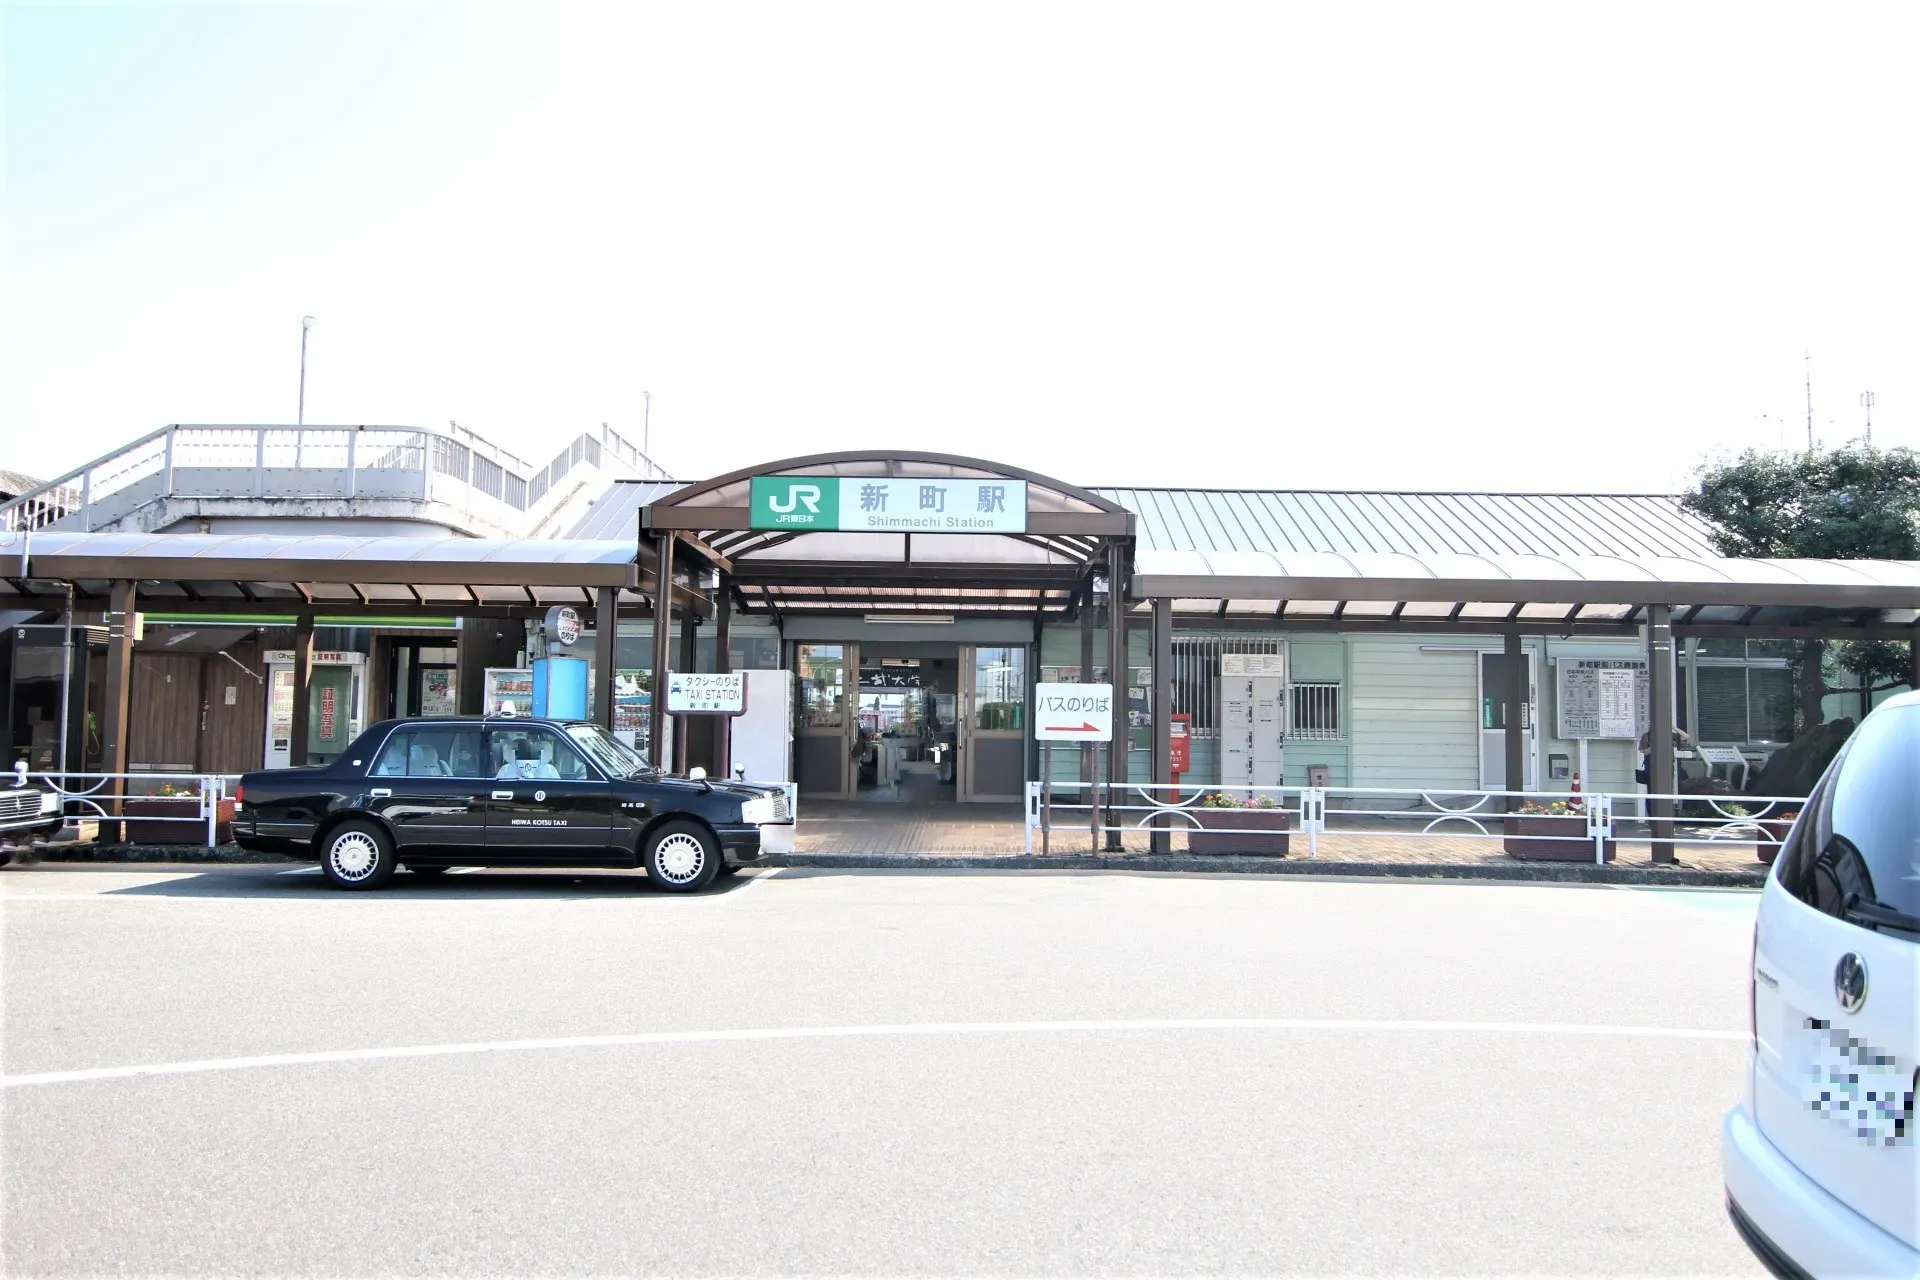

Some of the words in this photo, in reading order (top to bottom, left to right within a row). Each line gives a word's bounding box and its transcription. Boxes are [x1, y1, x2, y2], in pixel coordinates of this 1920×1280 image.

[768, 484, 821, 513] JR
[860, 483, 1006, 513] 新町駅
[775, 514, 815, 523] JR東日本
[867, 516, 941, 527] Shimmachi
[946, 517, 994, 528] Station
[560, 631, 575, 641] のりば
[686, 677, 739, 687] タクシーのりば
[685, 689, 703, 700] TAXI
[705, 689, 740, 700] STATION
[1038, 696, 1110, 712] バスのりば
[321, 688, 335, 738] 証明写真
